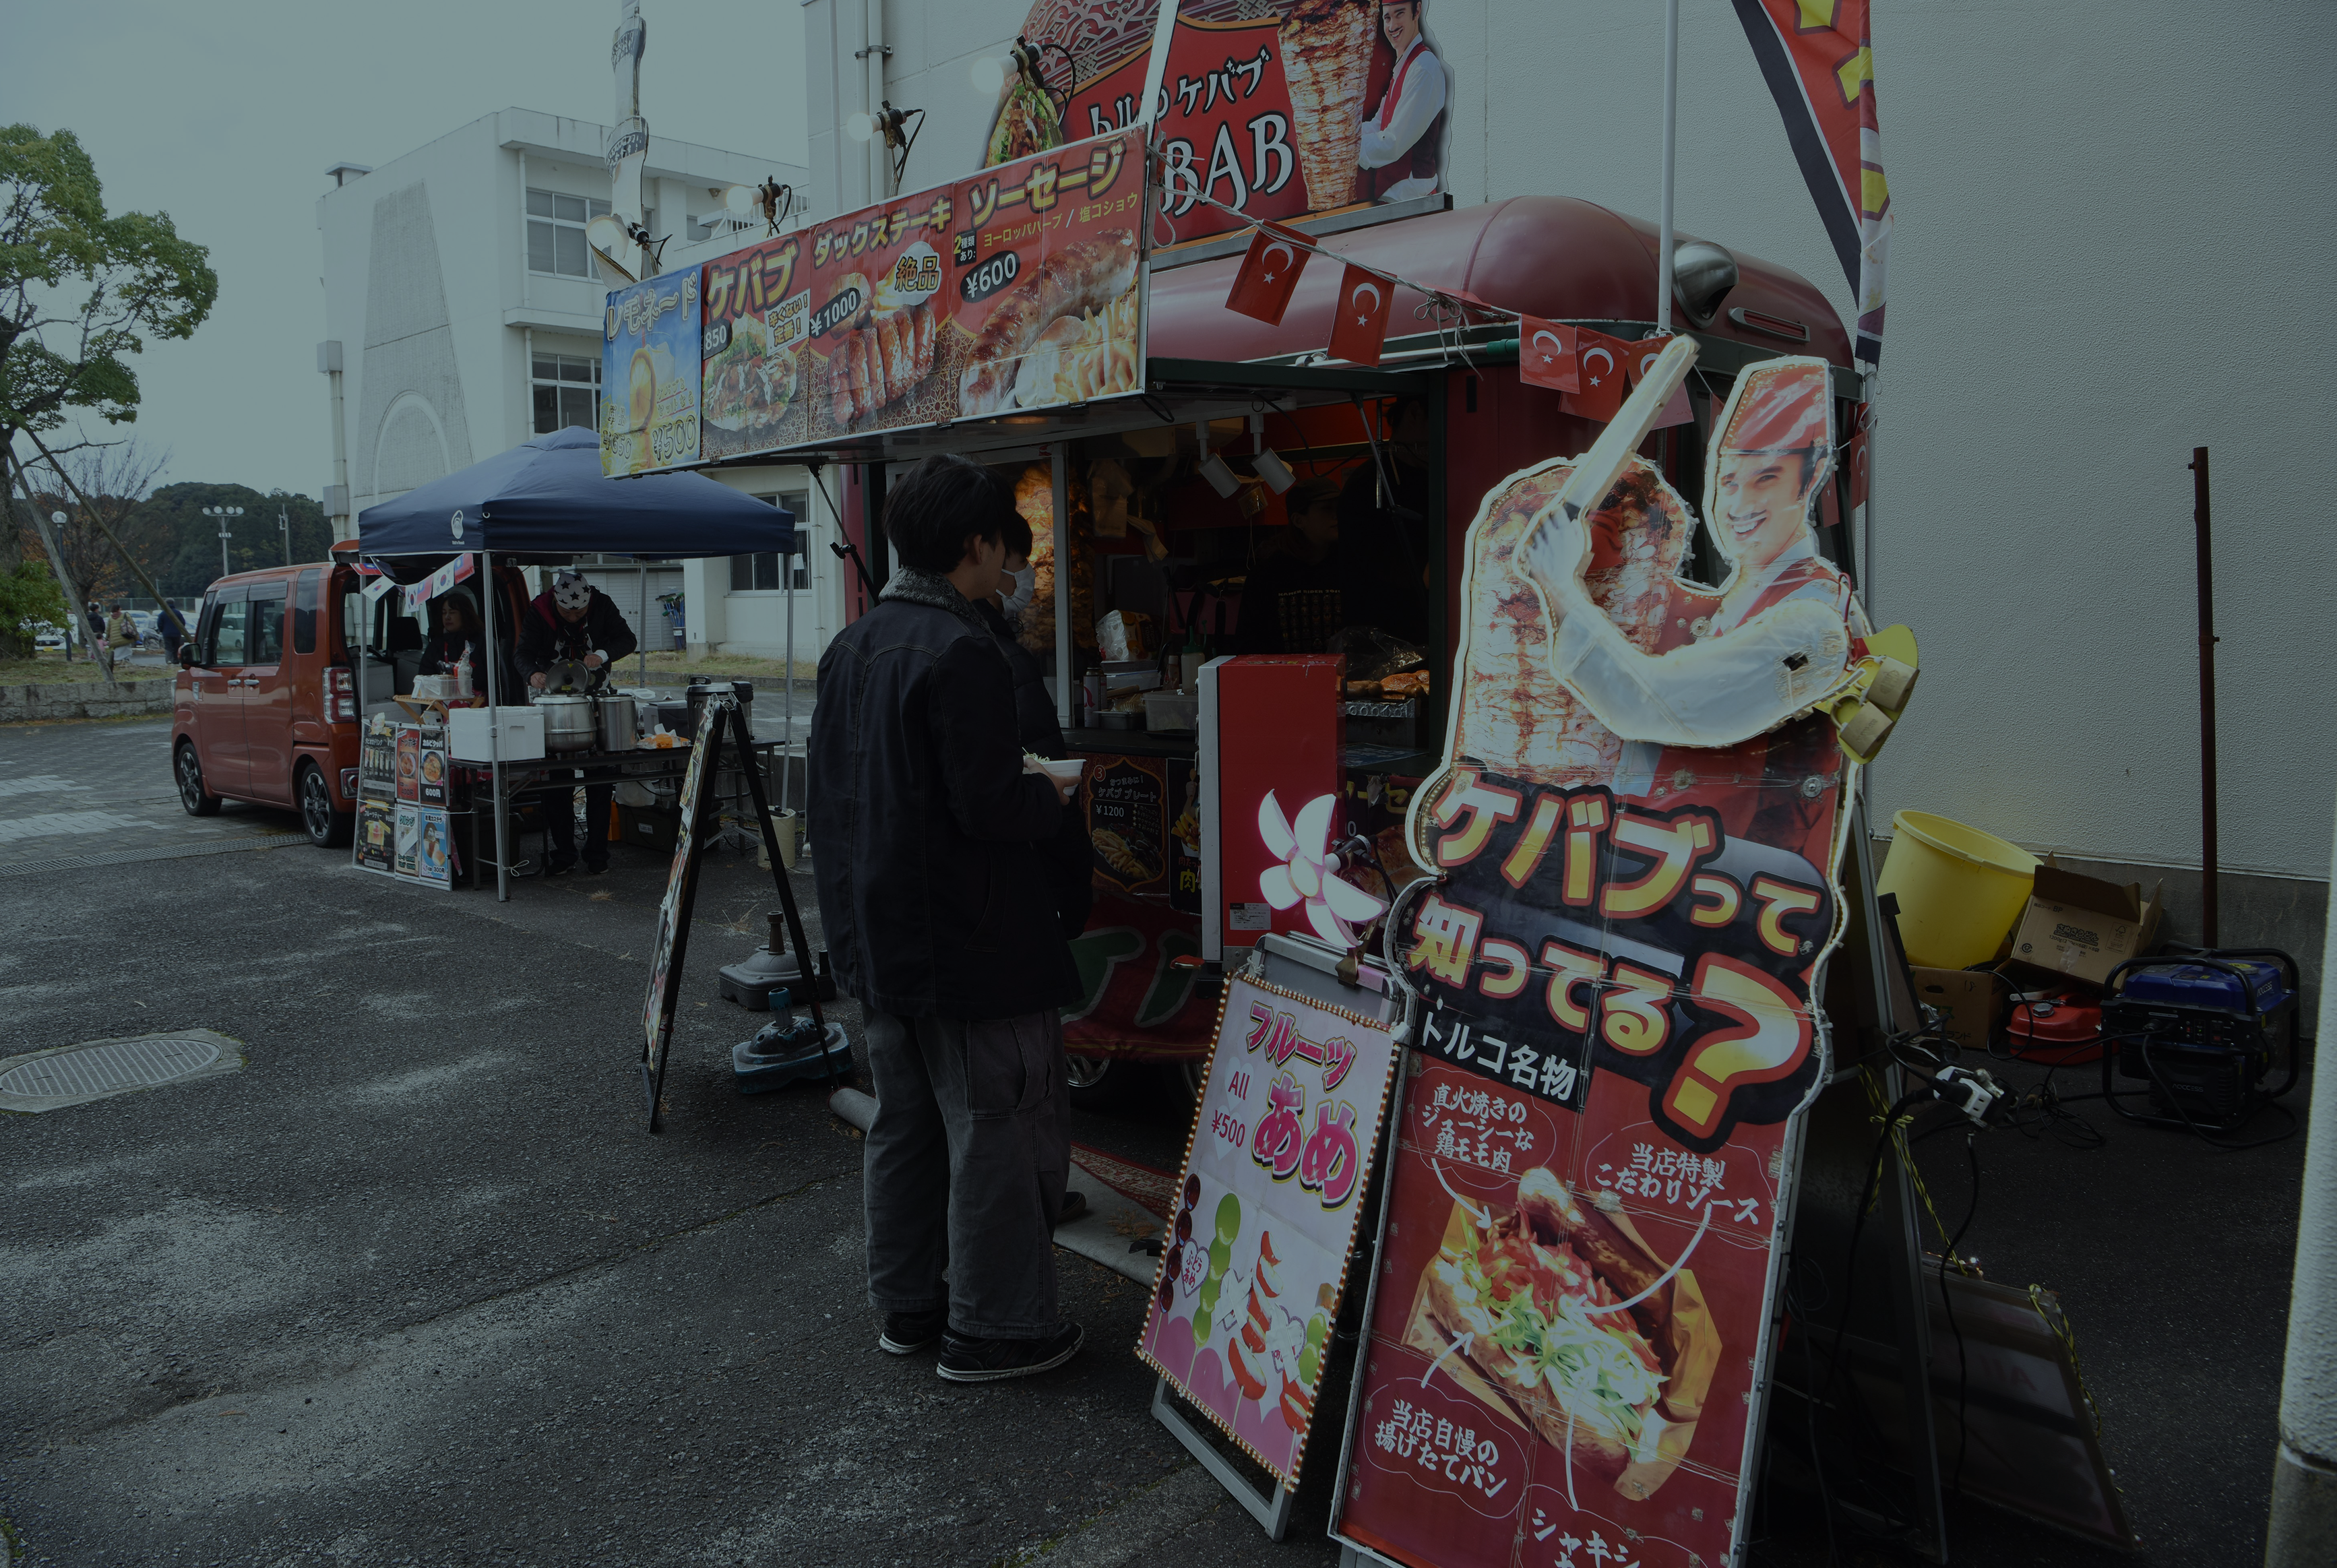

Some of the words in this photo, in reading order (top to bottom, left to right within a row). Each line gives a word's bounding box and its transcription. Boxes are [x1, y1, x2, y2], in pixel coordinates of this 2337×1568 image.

[969, 139, 1126, 230] ソーセージ
[813, 197, 952, 268] ダックステーキ
[984, 214, 1062, 247] ヨーロッパハーブ
[1079, 191, 1139, 224] 塩コショウ
[706, 239, 799, 319] ケバブ
[895, 256, 939, 292] 絶品
[966, 253, 1017, 299] ¥600
[606, 271, 697, 341] レモネード
[768, 293, 808, 328] 辛くない！
[809, 290, 857, 337] ¥1000
[702, 324, 727, 352] 850
[774, 317, 802, 348] 定番！
[608, 405, 626, 427] 単品
[602, 429, 633, 460] ¥650
[652, 414, 697, 463] ¥500
[425, 788, 441, 798] 600円
[1096, 804, 1125, 818] ¥1200
[1179, 856, 1199, 868] 肉たっ
[1180, 868, 1202, 893] 肉
[1432, 766, 1821, 958] ケバブって
[2053, 905, 2063, 913] BP
[2056, 922, 2099, 942] さぬきうどん
[1246, 1001, 1357, 1094] フルーツ
[1421, 1011, 1578, 1101] トルコ名物
[1930, 1030, 1972, 1041] ハランド
[1228, 1071, 1251, 1100] All
[1433, 1082, 1528, 1124] 直火焼きの
[1211, 1109, 1245, 1148] ¥500
[1251, 1069, 1360, 1213] あめ
[1422, 1104, 1534, 1152] ジューシーな
[1435, 1132, 1512, 1174] 鶏モモ肉
[1629, 1142, 1726, 1191] 当店特製
[1594, 1163, 1760, 1225] こだわりソース
[1391, 1398, 1499, 1466] 当店自慢の
[1375, 1420, 1507, 1498] 揚げたてパン
